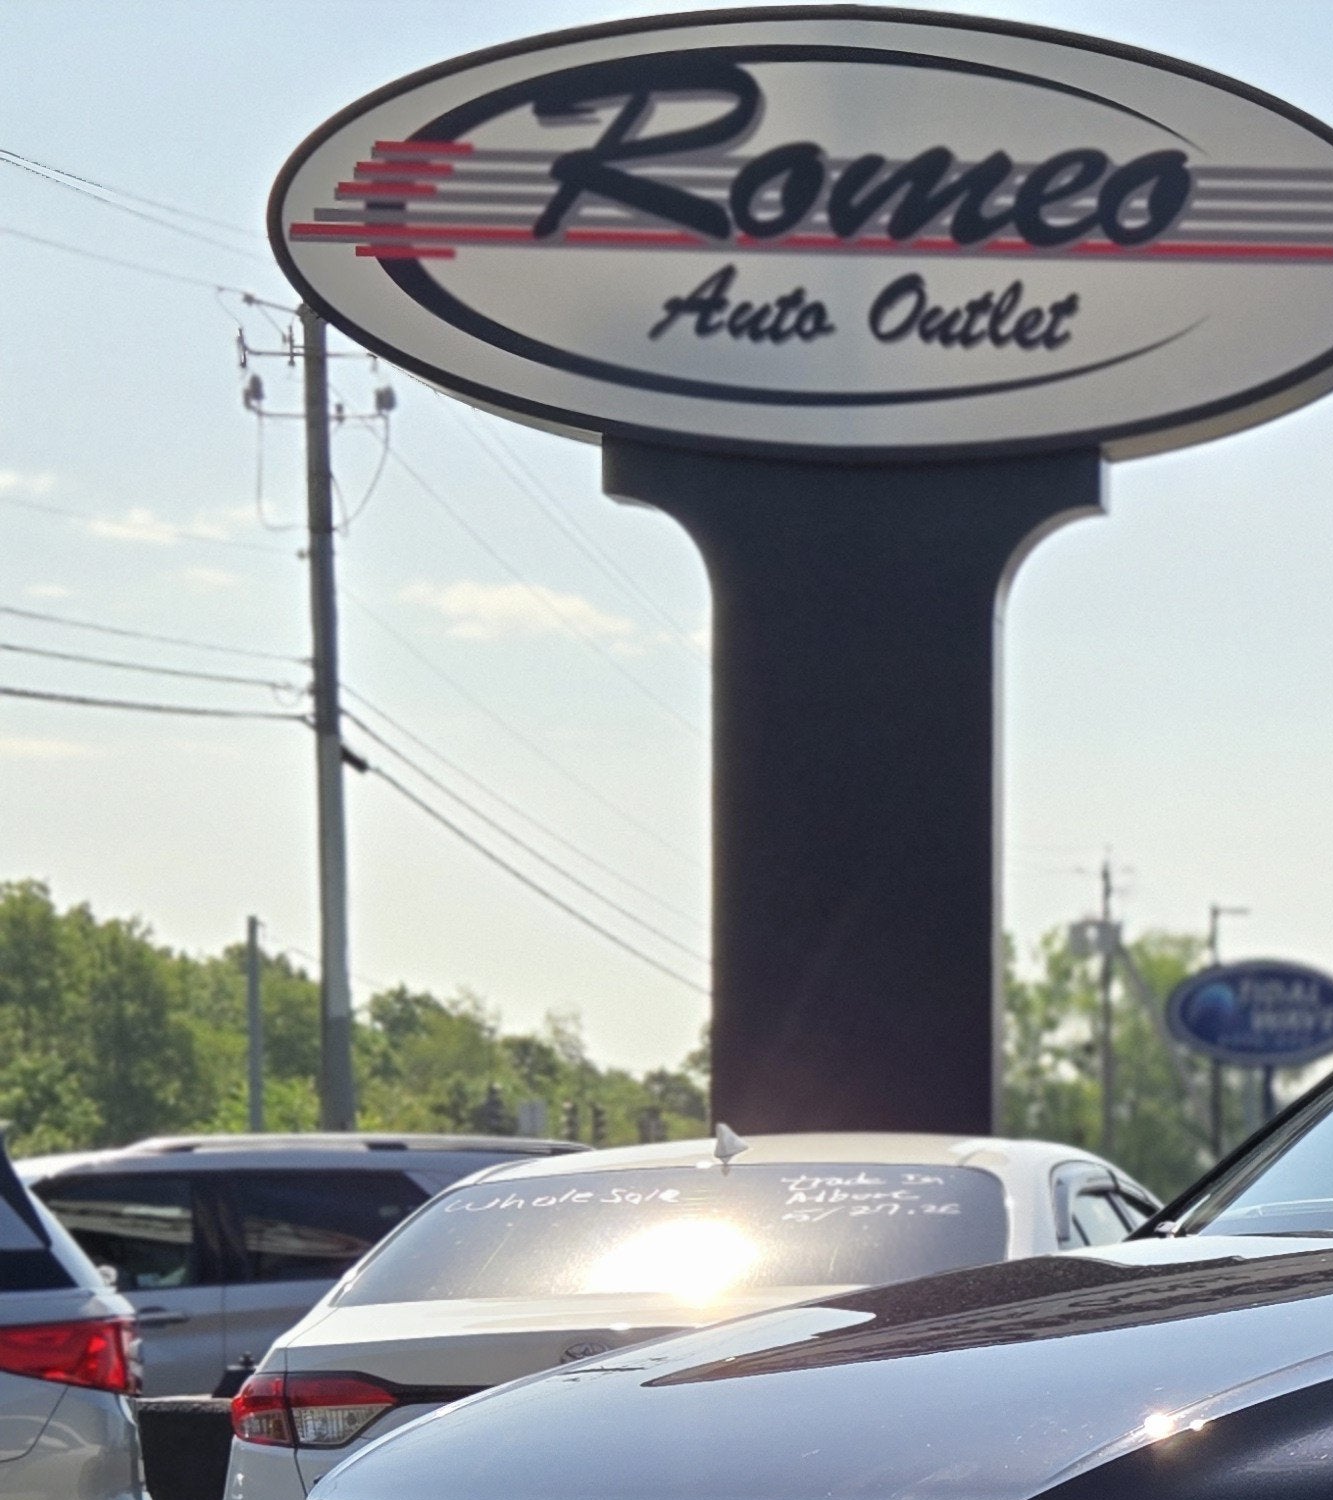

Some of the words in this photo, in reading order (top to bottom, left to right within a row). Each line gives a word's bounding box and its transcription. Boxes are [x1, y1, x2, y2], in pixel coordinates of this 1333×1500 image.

[532, 56, 1194, 247] Romeo
[648, 263, 836, 345] Auto
[868, 272, 1079, 351] Outlet
